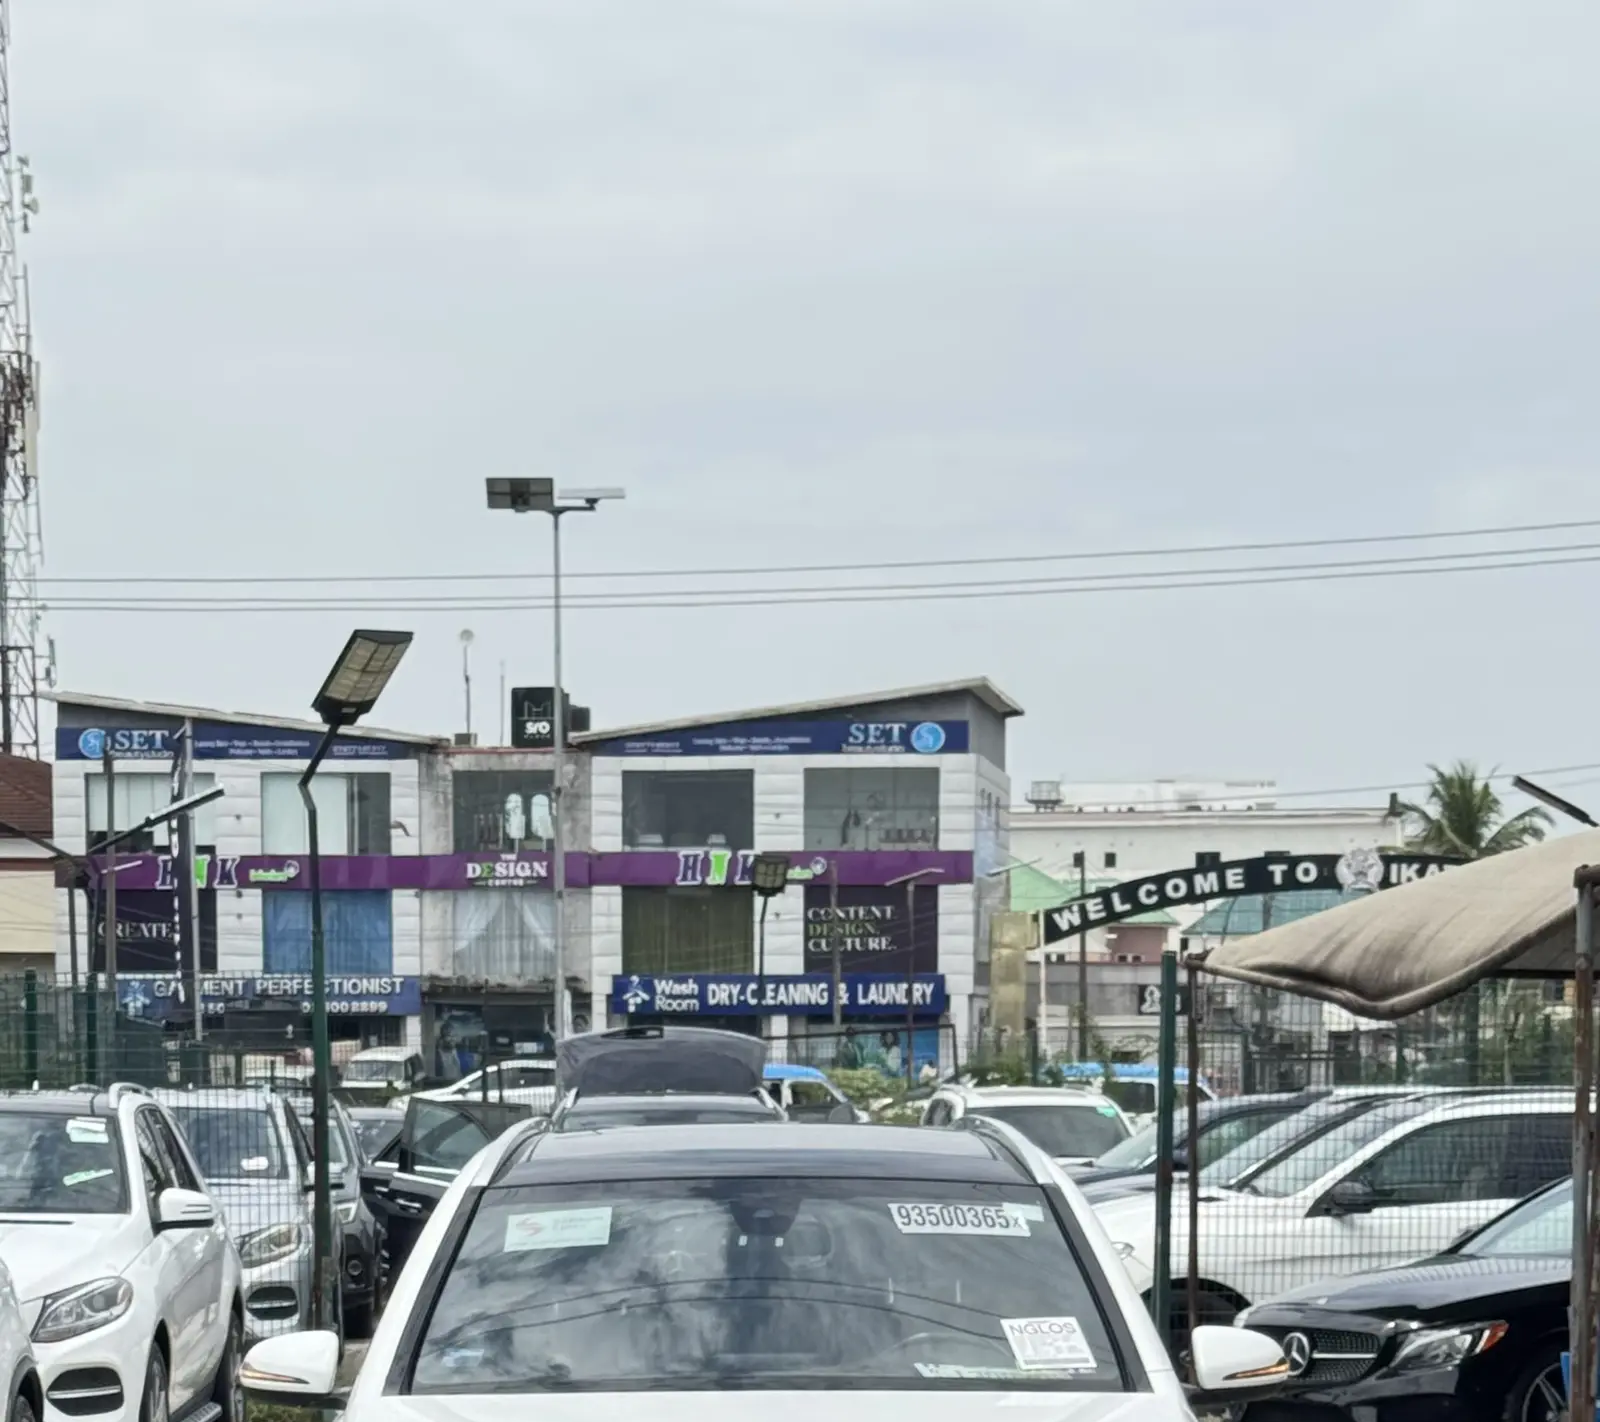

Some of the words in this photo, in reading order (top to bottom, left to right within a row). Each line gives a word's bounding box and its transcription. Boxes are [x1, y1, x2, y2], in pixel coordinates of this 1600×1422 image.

[114, 730, 169, 750] SET
[848, 722, 907, 744] SET
[466, 861, 548, 879] DESIGN
[1052, 868, 1246, 932] WELCOME
[1267, 862, 1318, 886] TO
[654, 978, 699, 996] Wash
[655, 995, 699, 1012] Room
